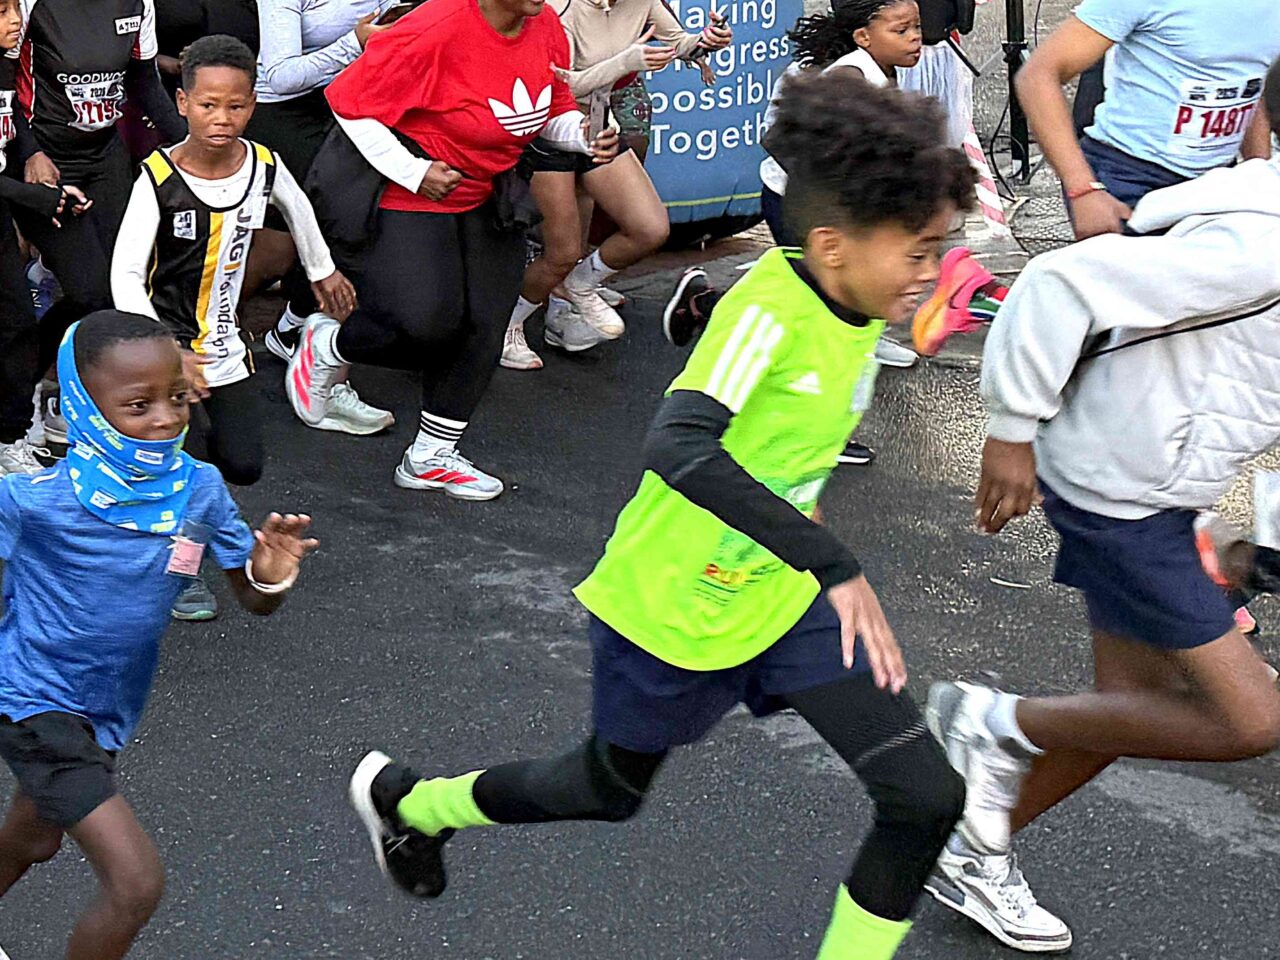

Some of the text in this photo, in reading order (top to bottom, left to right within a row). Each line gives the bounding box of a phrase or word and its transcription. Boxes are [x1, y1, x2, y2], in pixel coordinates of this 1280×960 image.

[56, 71, 123, 85] GOODWO
[648, 70, 772, 114] possibl
[651, 112, 769, 160] Togeth
[1173, 106, 1193, 134] P
[229, 208, 252, 262] JAG
